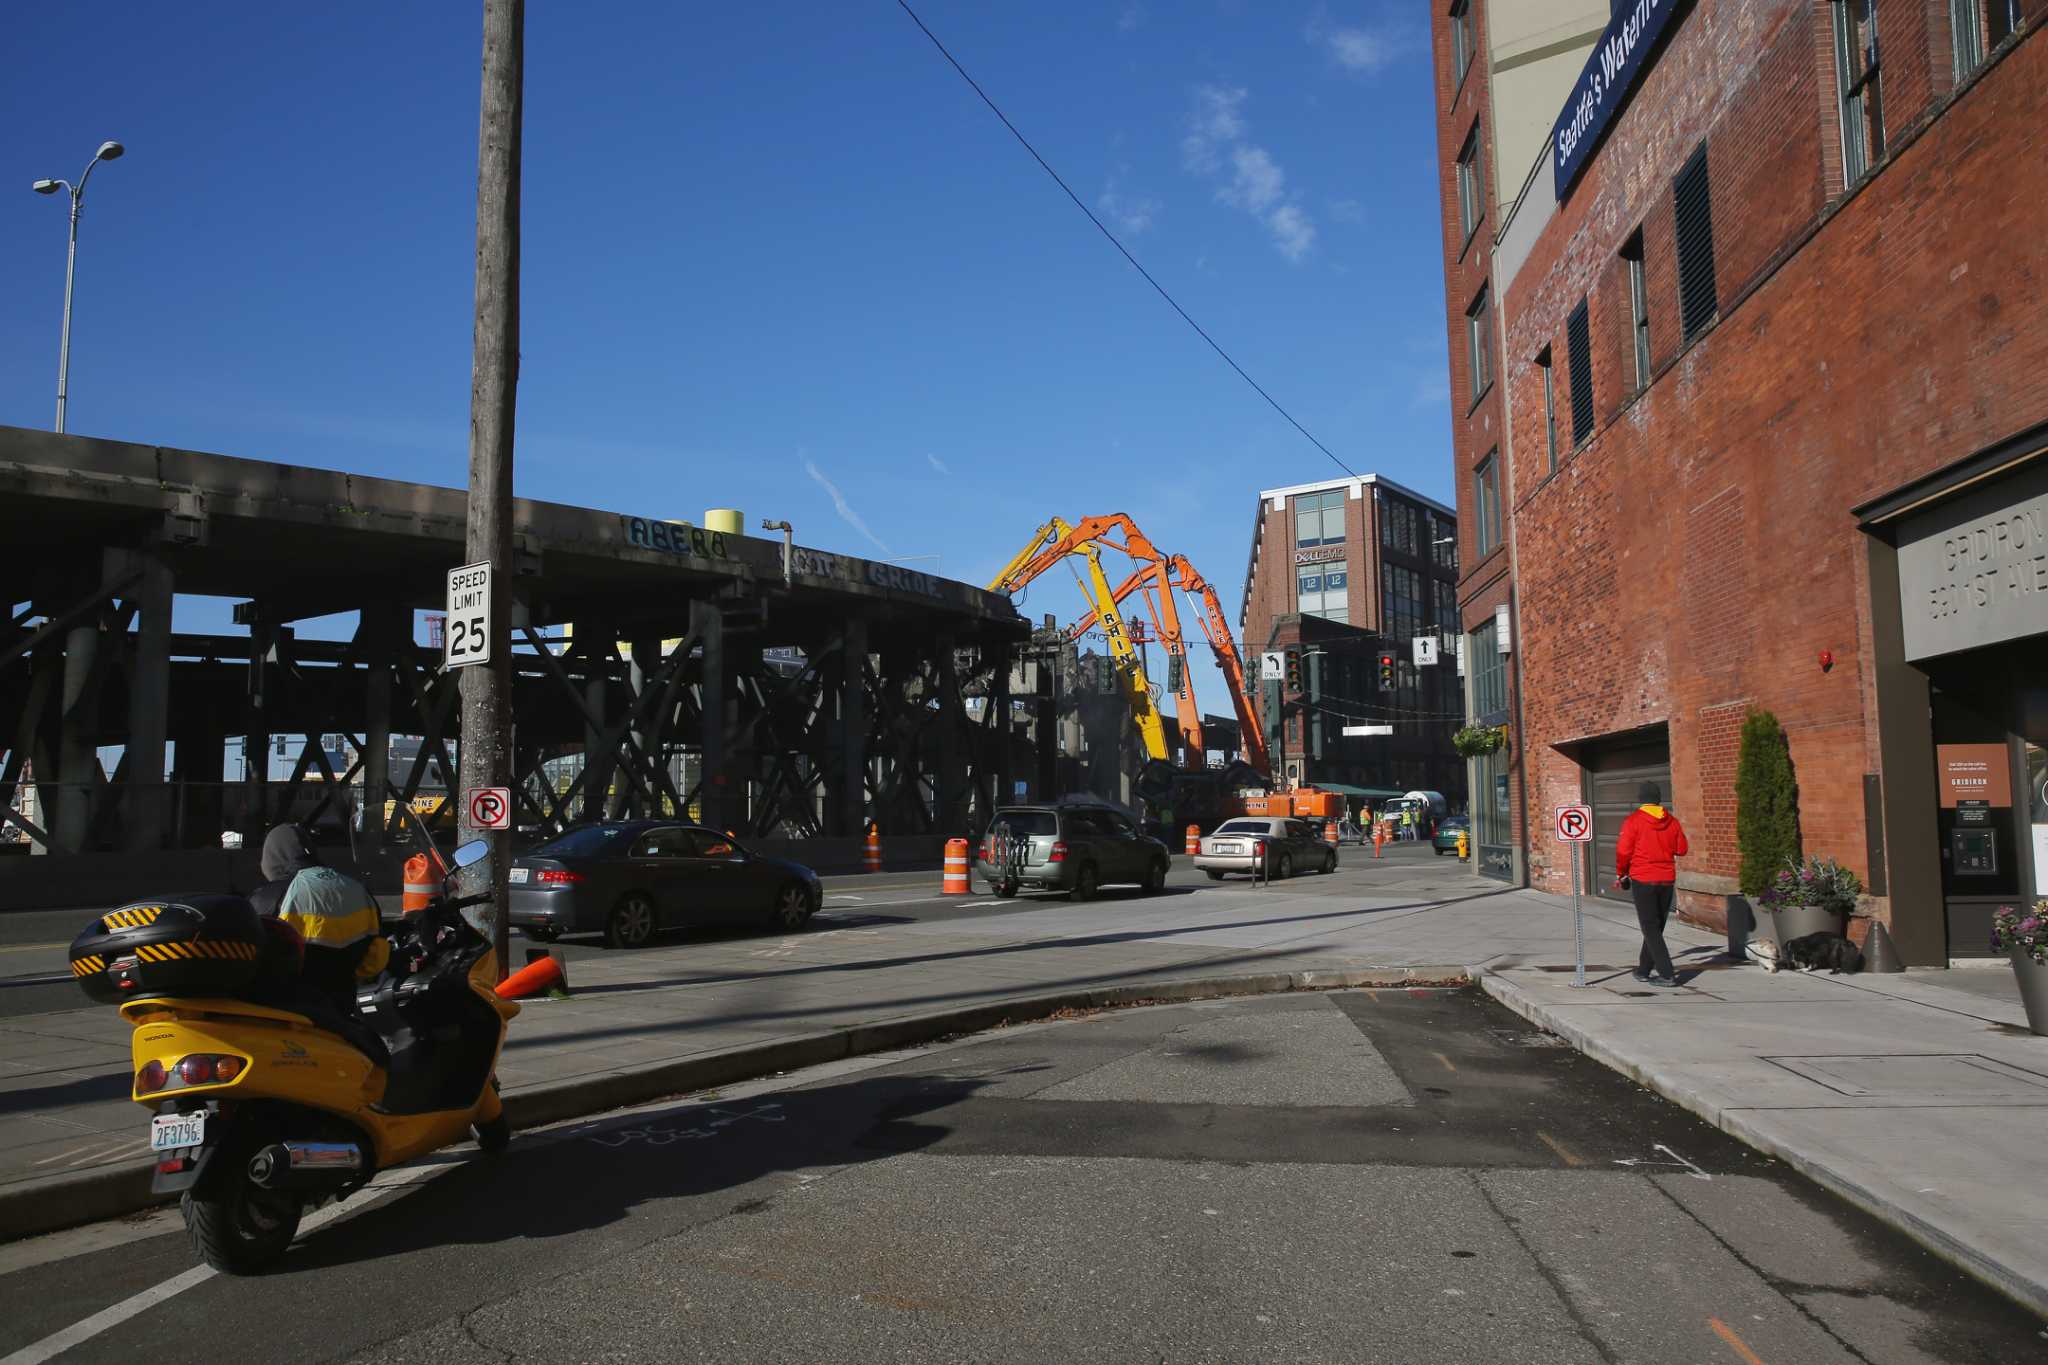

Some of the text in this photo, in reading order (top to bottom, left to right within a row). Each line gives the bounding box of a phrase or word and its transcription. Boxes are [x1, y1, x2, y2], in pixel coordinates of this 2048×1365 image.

[1559, 73, 1602, 167] Seattle's
[1943, 507, 2043, 574] GRIDIRON
[452, 570, 487, 591] SPEED
[1306, 579, 1317, 589] 12
[1332, 575, 1342, 585] 12
[454, 591, 483, 610] LIMIT
[451, 617, 486, 656] 25
[1105, 613, 1136, 678] RHINE
[1952, 778, 1987, 786] GRIDIRON
[157, 1123, 197, 1145] 2F3796
